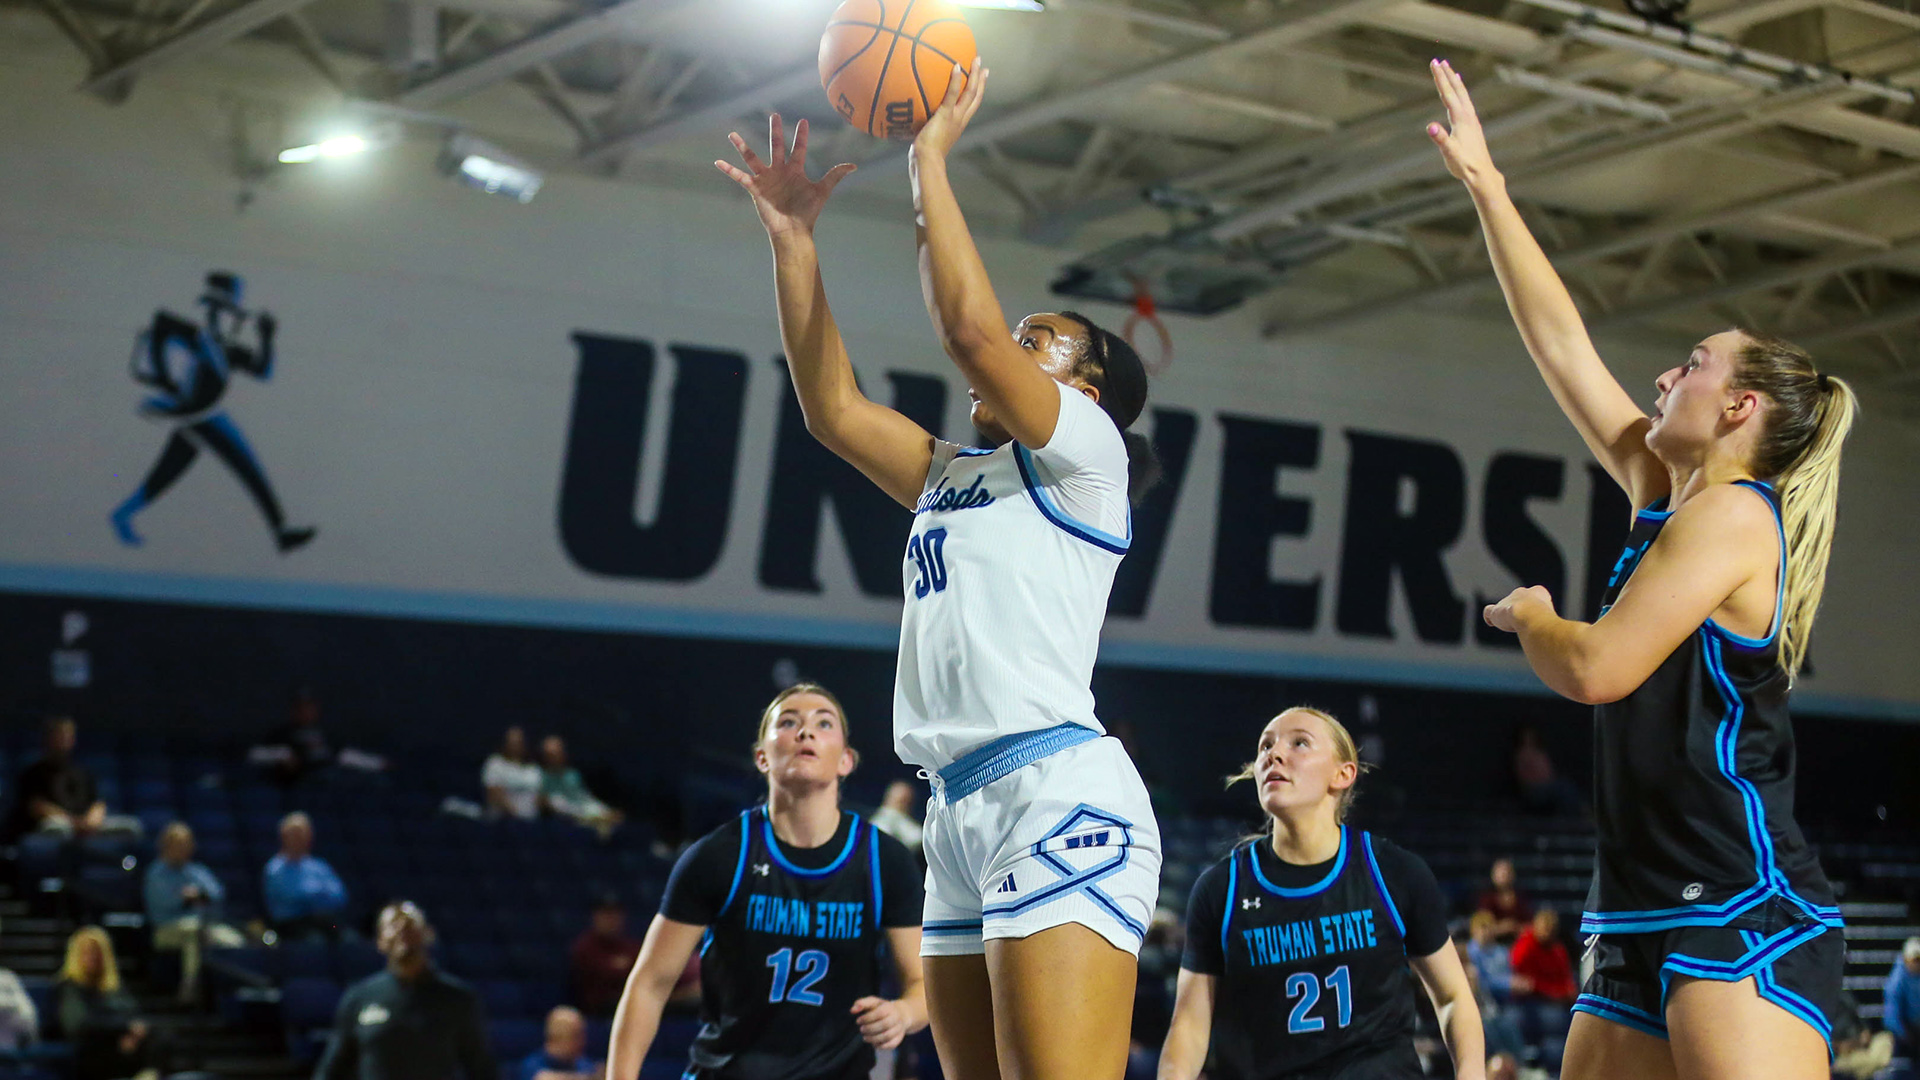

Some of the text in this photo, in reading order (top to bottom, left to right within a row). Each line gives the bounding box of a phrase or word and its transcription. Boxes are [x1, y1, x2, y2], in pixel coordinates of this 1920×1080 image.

[907, 526, 948, 600] 30
[745, 894, 864, 940] TRUMAN STATE
[1242, 909, 1377, 967] TRUMAN STATE
[766, 947, 830, 1007] 12
[1285, 965, 1353, 1035] 21
